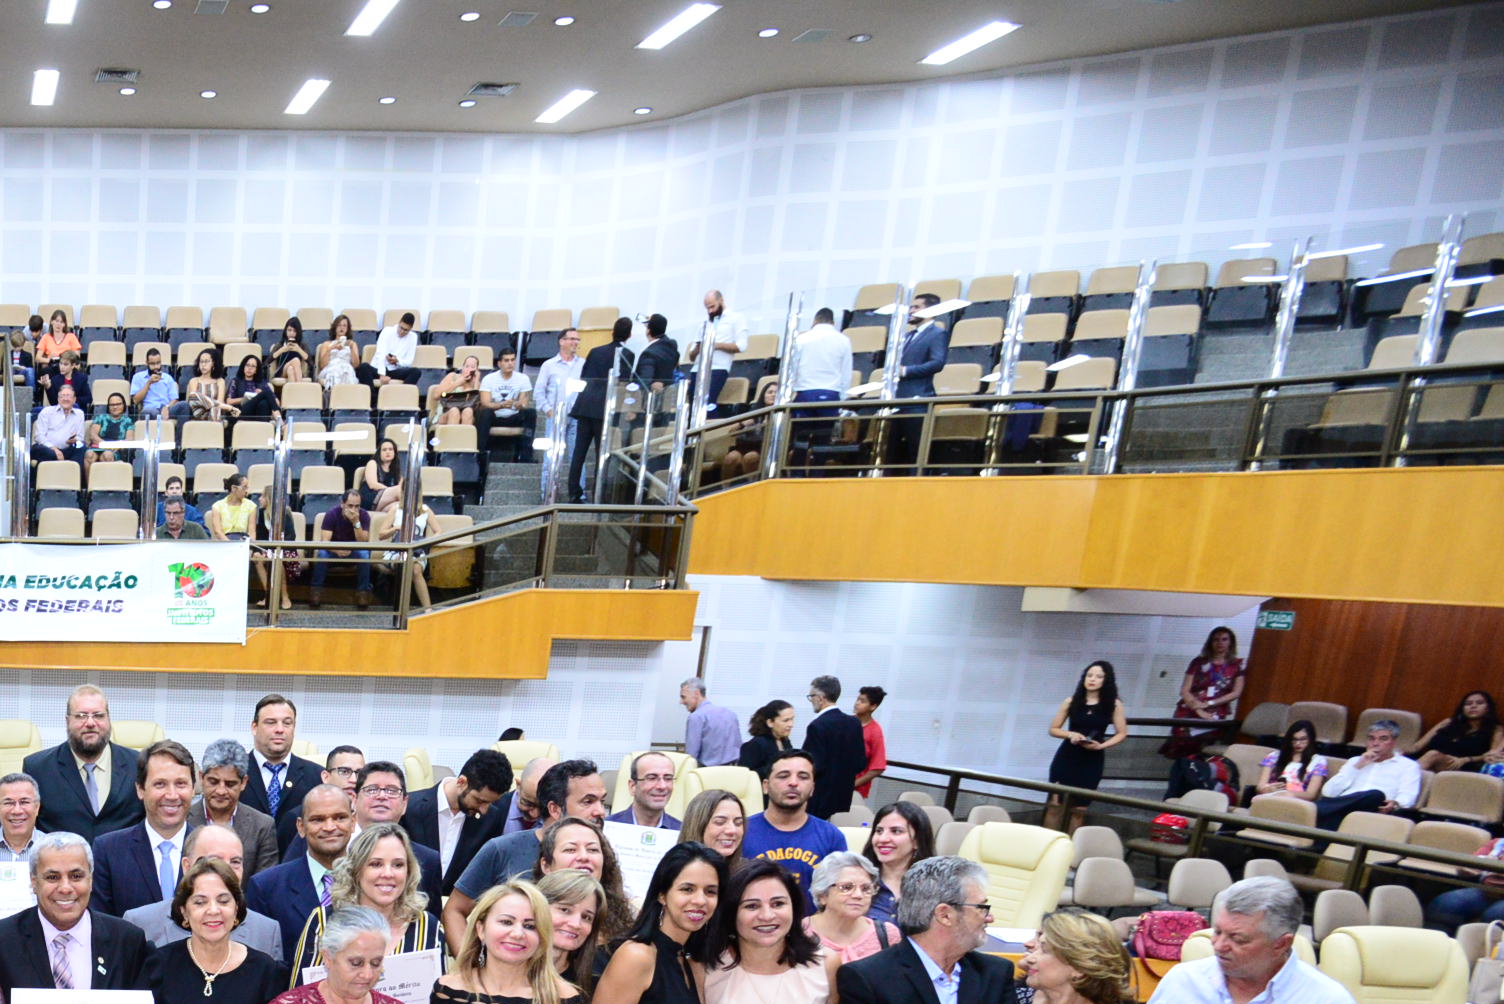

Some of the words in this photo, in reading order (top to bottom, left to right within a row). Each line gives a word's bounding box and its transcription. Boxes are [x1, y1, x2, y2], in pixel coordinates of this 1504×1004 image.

[23, 571, 138, 592] EDUCAÇÃO
[24, 599, 124, 613] FEDERAIS
[756, 847, 821, 869] DAGOGI
